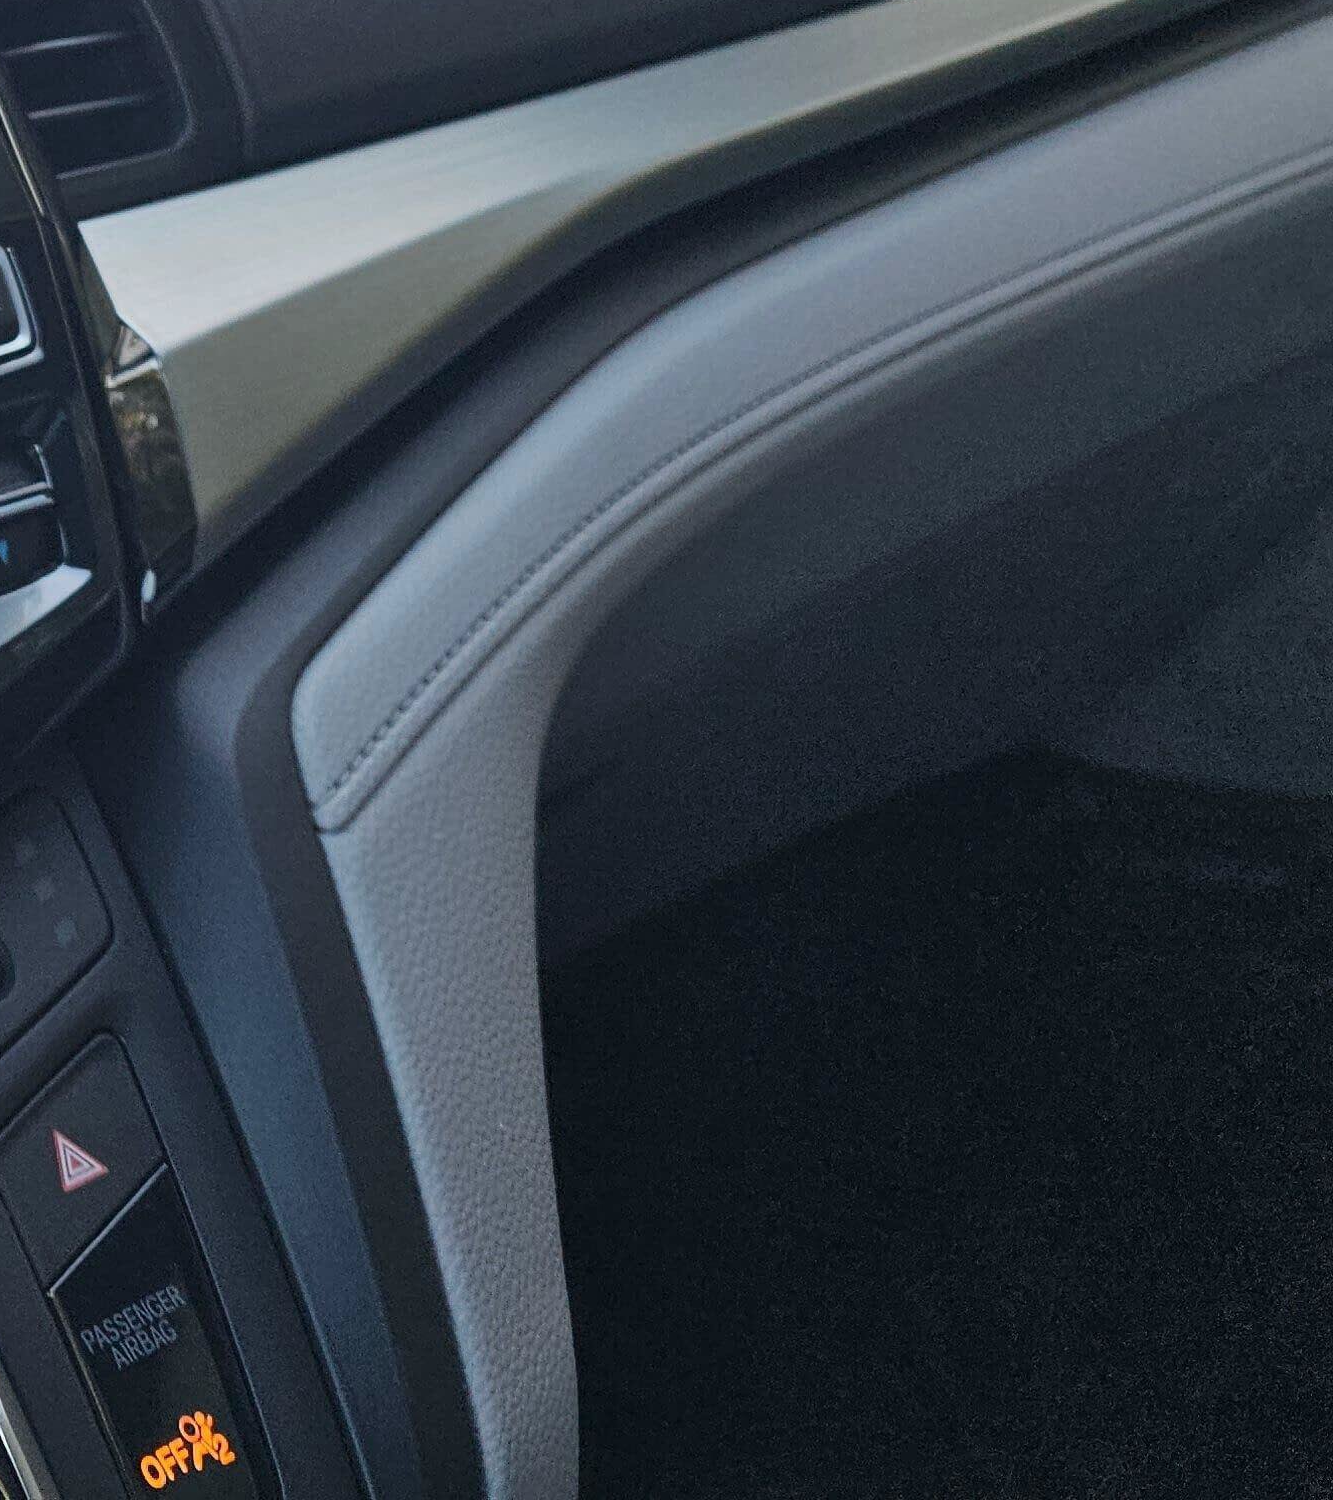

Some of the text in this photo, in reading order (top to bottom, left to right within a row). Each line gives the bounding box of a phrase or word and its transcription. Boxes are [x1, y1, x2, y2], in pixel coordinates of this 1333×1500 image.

[80, 1284, 186, 1355] PASSENGER
[111, 1319, 177, 1371] AIRBAG
[140, 1437, 189, 1489] OFF
